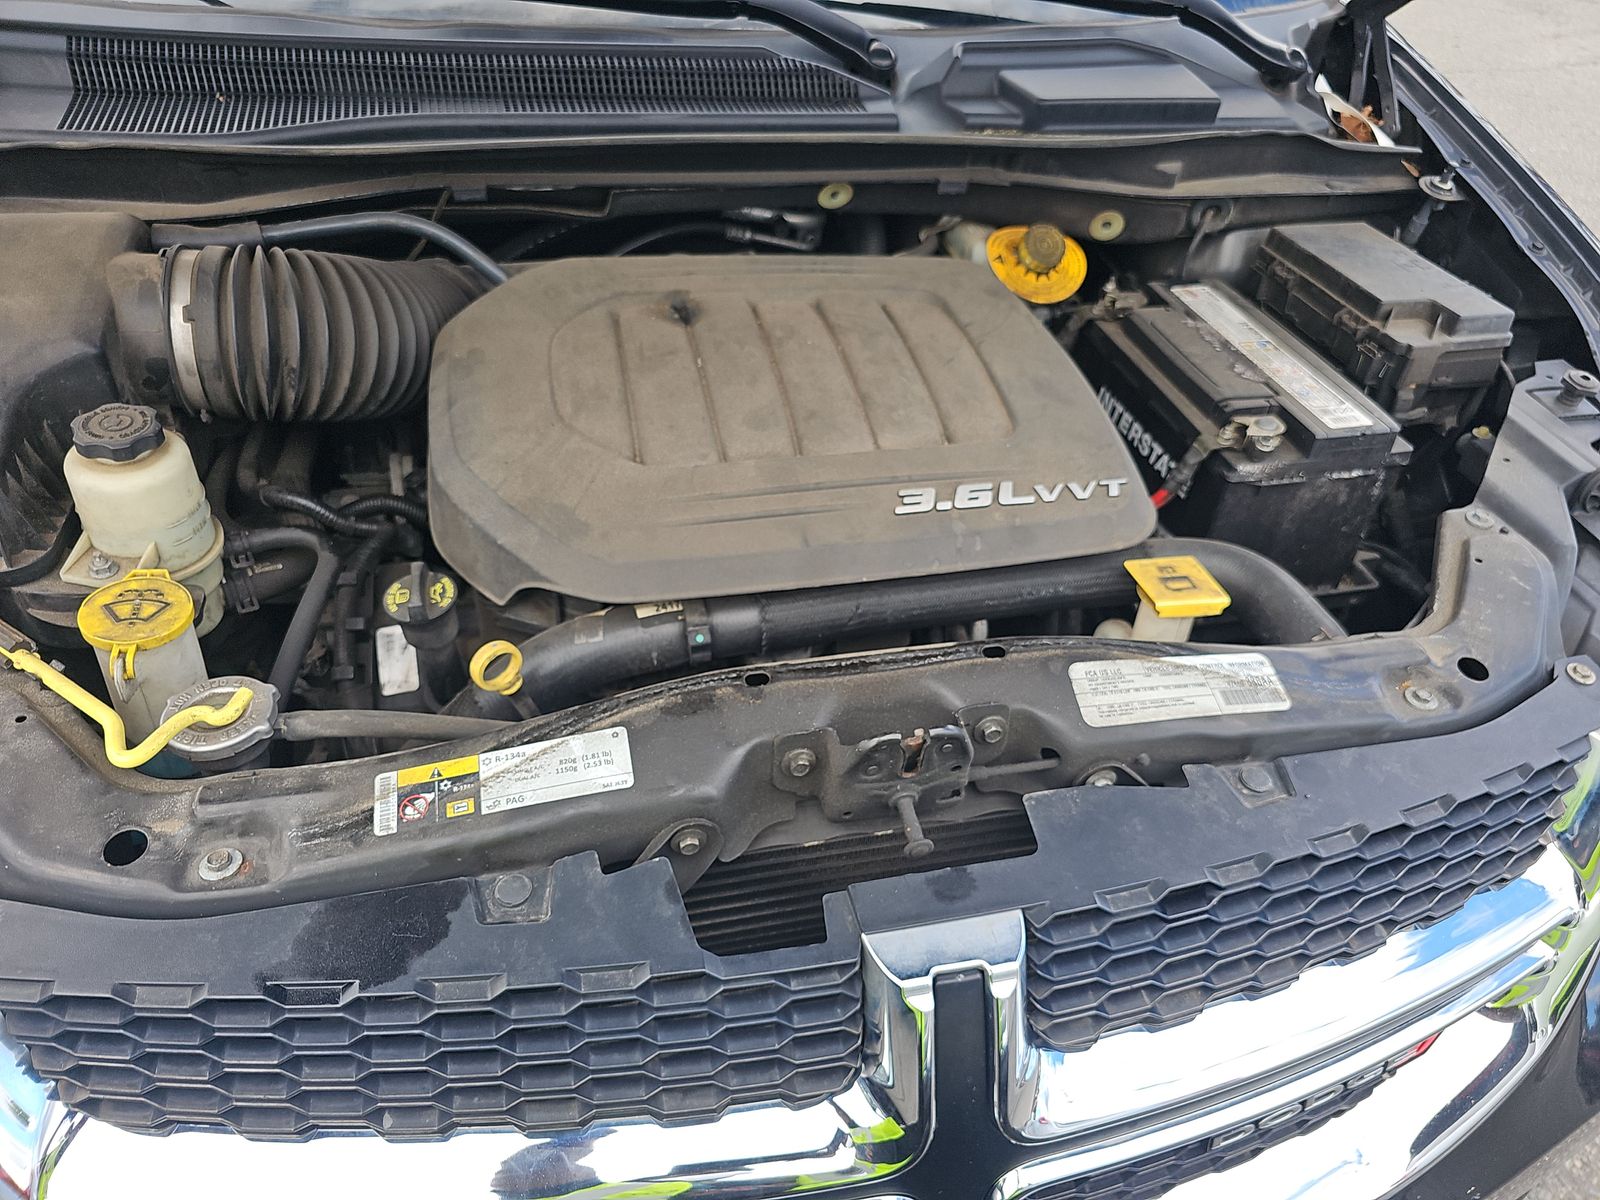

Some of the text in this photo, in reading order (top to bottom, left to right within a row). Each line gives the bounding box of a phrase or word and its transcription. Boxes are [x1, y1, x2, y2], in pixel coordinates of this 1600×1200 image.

[1100, 386, 1179, 484] INTERSTA
[174, 732, 208, 746] TIGH
[495, 751, 527, 764] R-134a
[558, 756, 578, 766] 820g
[555, 765, 578, 775] 1150g
[506, 795, 525, 806] PAG
